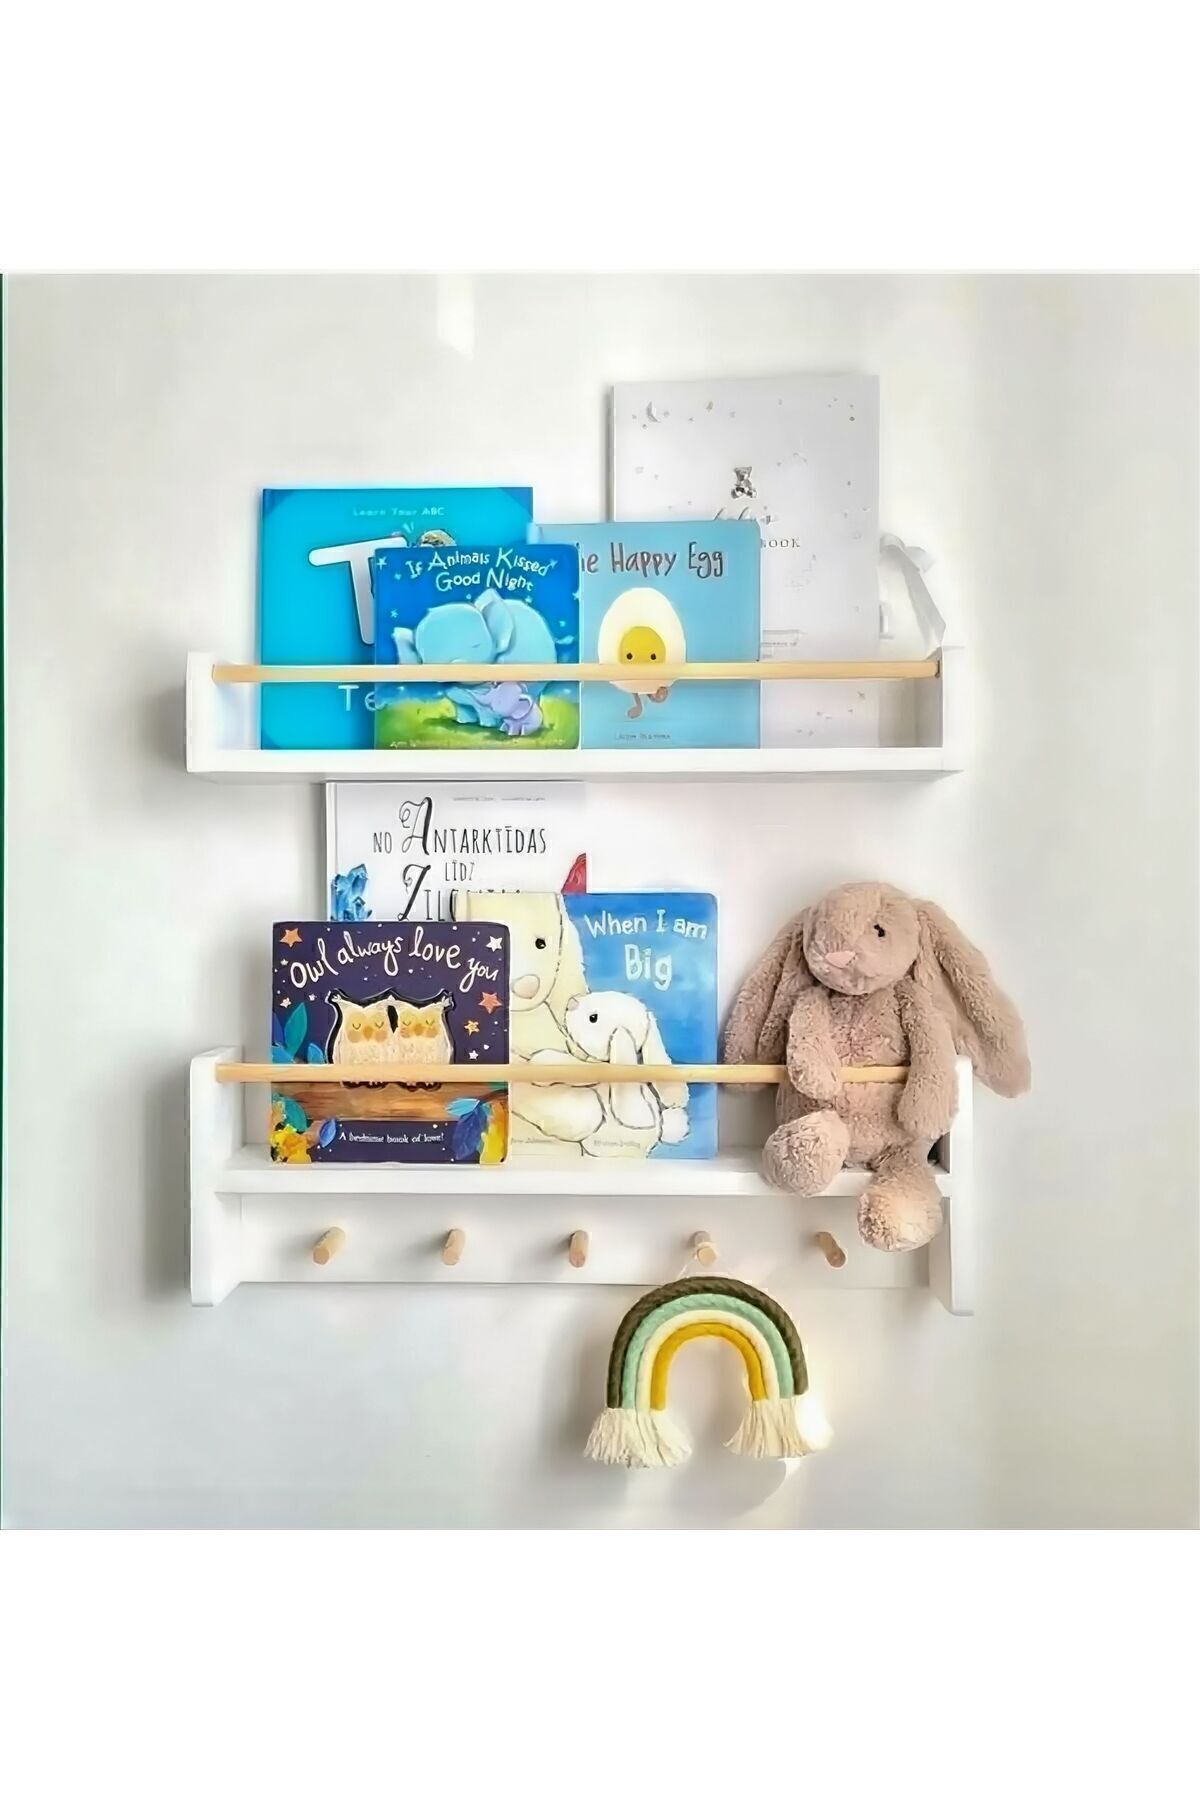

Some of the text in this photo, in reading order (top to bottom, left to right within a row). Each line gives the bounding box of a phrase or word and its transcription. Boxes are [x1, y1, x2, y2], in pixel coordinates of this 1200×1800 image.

[421, 507, 445, 516] ABC
[405, 547, 548, 579] If Animals Kissed
[610, 542, 677, 578] Happy
[688, 541, 724, 579] Egg
[435, 567, 534, 592] Good Night
[373, 831, 393, 855] NO
[583, 908, 709, 940] When I am
[289, 926, 499, 993] Owl always love you
[624, 943, 674, 992] Big
